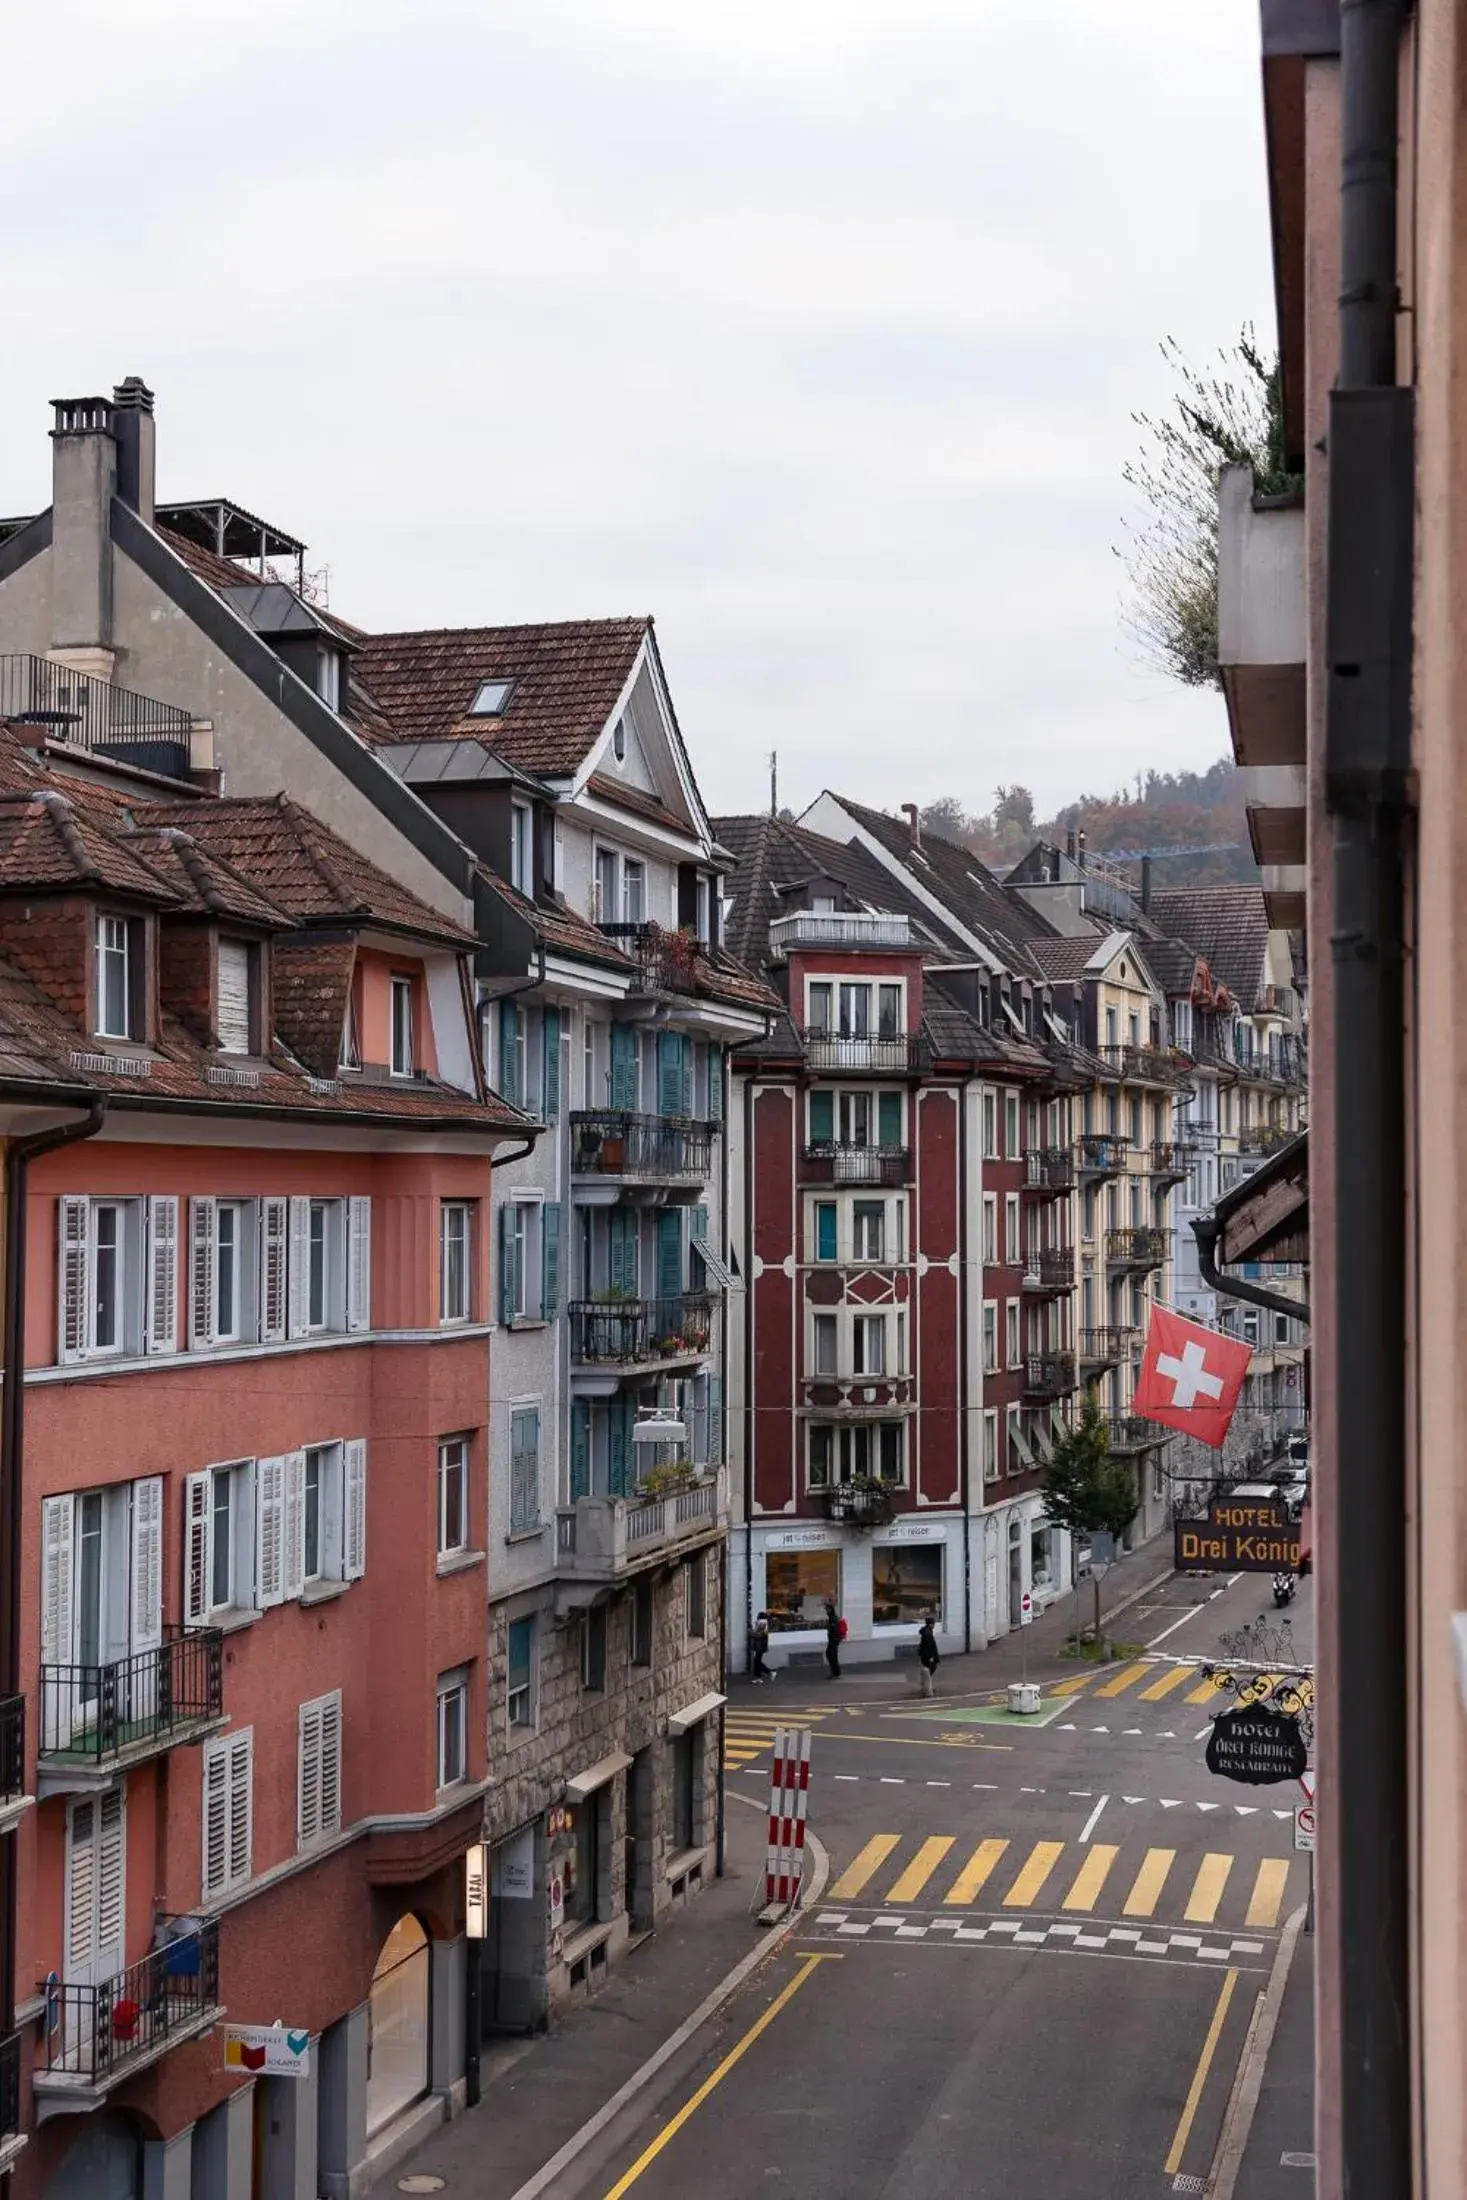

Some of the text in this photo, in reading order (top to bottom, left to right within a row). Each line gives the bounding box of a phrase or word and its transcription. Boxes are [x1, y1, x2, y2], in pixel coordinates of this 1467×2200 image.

[1216, 1508, 1283, 1528] HOTEL
[1182, 1534, 1301, 1566] Drei König
